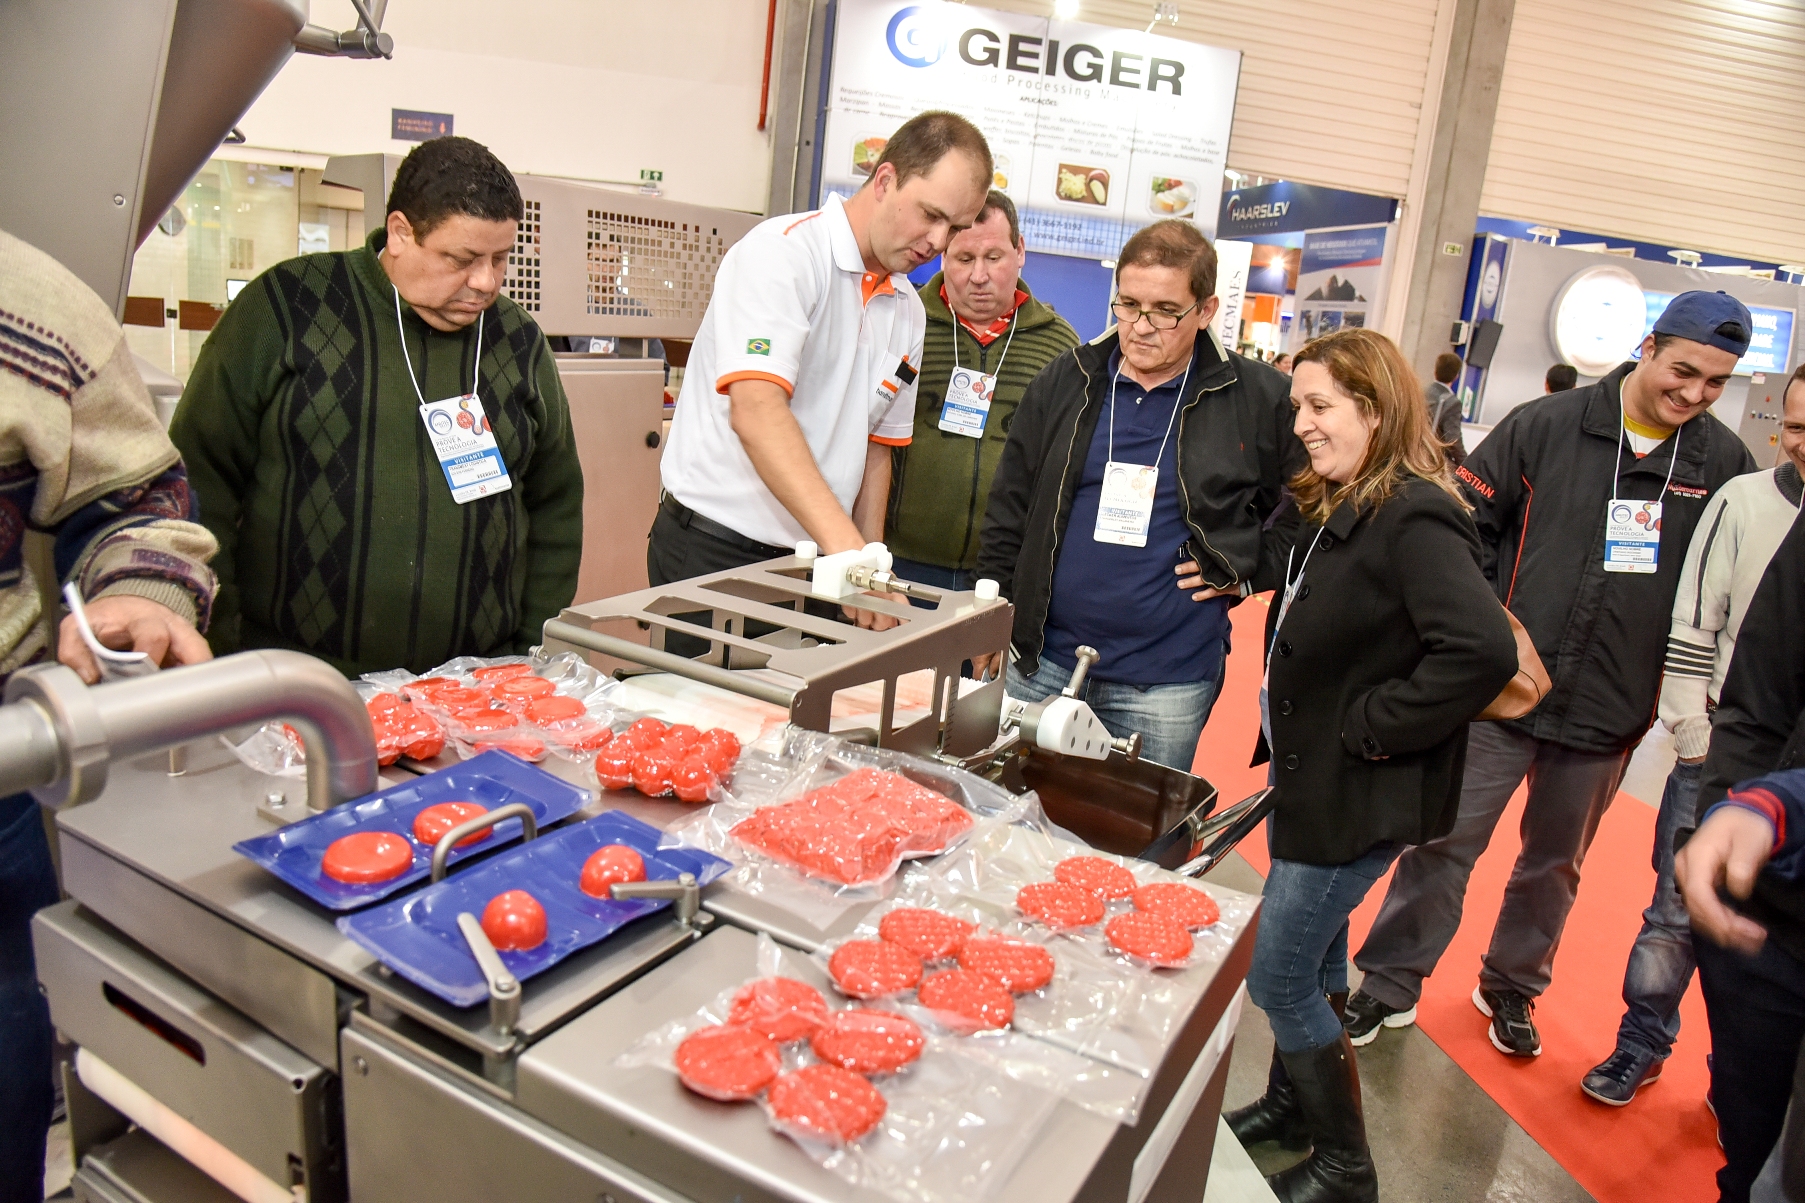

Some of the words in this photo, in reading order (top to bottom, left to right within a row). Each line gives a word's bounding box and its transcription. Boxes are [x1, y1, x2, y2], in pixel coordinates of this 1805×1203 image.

[958, 28, 1186, 96] GEIGER
[1006, 74, 1091, 100] Processing
[1231, 200, 1291, 222] HAARSLEV
[435, 437, 457, 448] PROVE
[437, 439, 478, 454] TECNOLOGIA
[453, 451, 485, 464] VISITANTE
[1455, 465, 1495, 499] CRISTIAN
